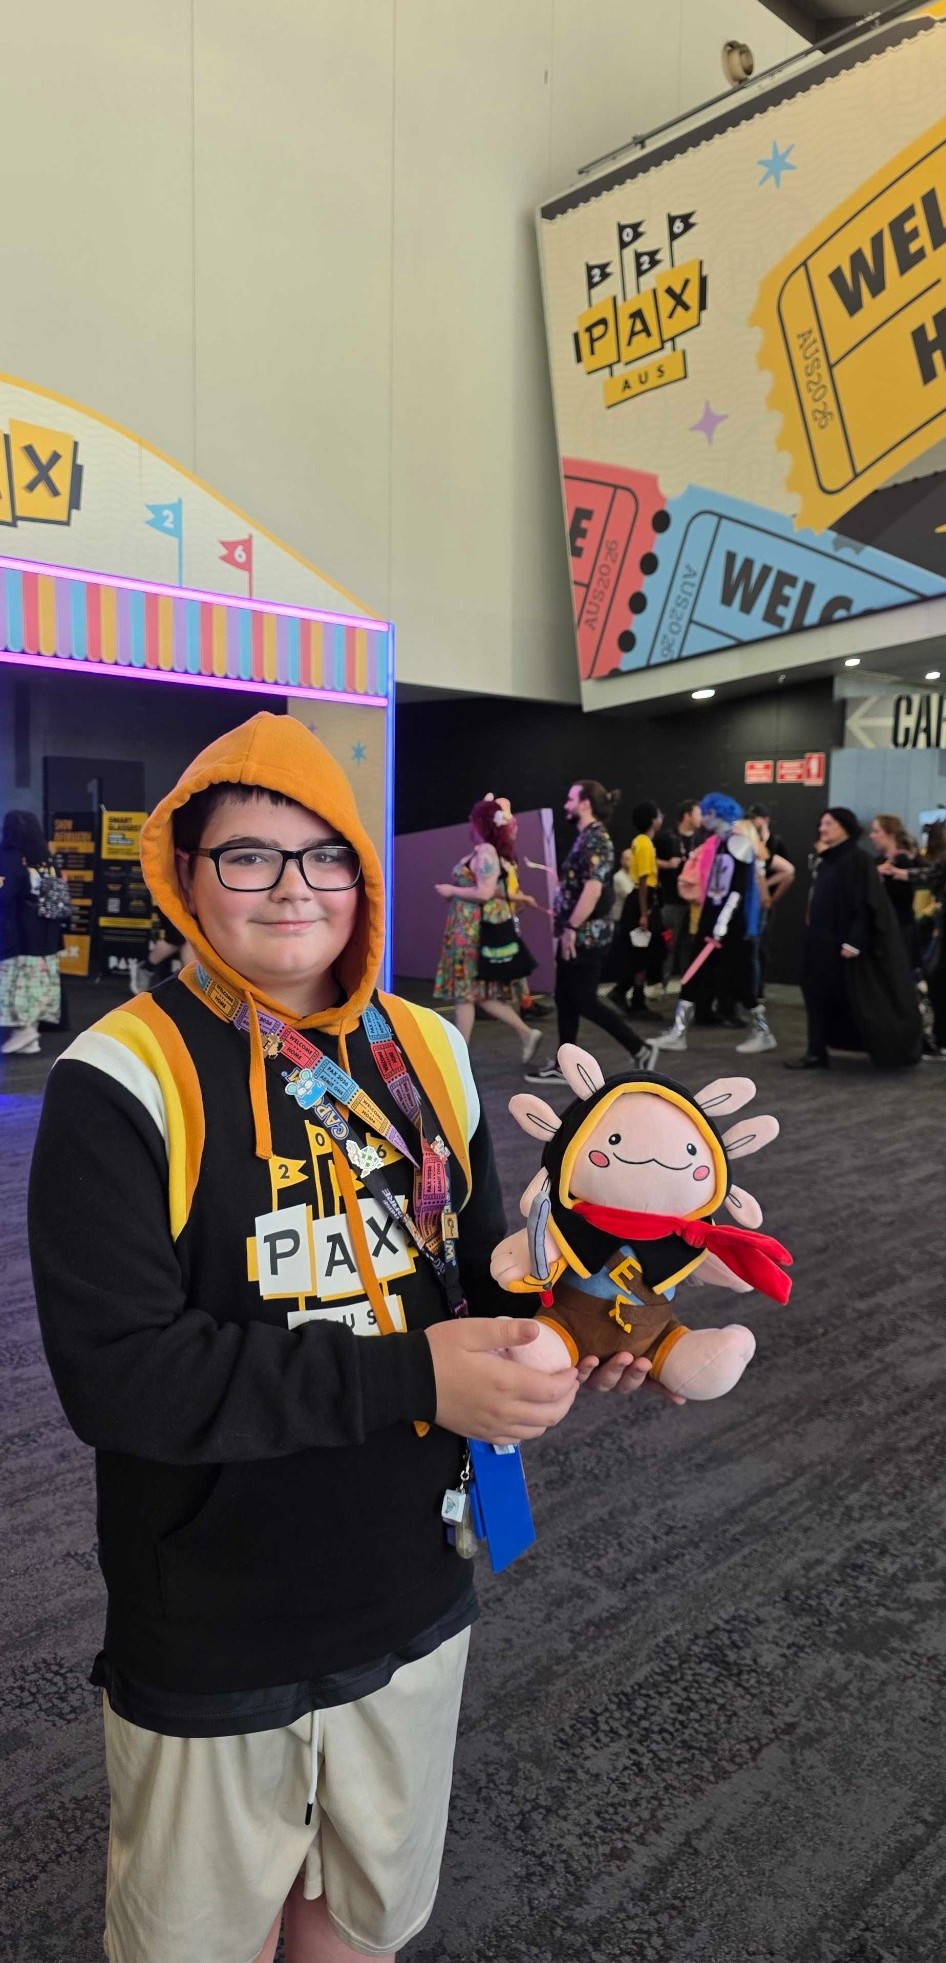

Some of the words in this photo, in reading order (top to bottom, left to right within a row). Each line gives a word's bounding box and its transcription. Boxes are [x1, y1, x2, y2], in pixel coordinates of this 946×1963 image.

[590, 269, 602, 283] 2
[622, 228, 634, 241] 0
[640, 255, 651, 270] 2
[673, 219, 684, 233] 6
[584, 277, 691, 356] PAX
[621, 366, 666, 392] AUS
[797, 329, 834, 429] AUS2026
[162, 510, 175, 528] 2
[233, 546, 247, 564] 6
[585, 539, 619, 631] AUS2026
[721, 549, 878, 632] WELC
[287, 1047, 302, 1060] HOME
[289, 1034, 313, 1055] WELCOME
[320, 1075, 334, 1089] ADMIT
[333, 1086, 344, 1095] ONE
[327, 1066, 338, 1077] PAX
[337, 1075, 348, 1087] 2026
[361, 1110, 376, 1124] HOME
[363, 1099, 382, 1121] WELCOME
[278, 1164, 289, 1179] 2
[315, 1132, 325, 1147] 0
[376, 1144, 387, 1159] 6
[263, 1216, 399, 1277] PAX
[309, 1308, 377, 1329] US
